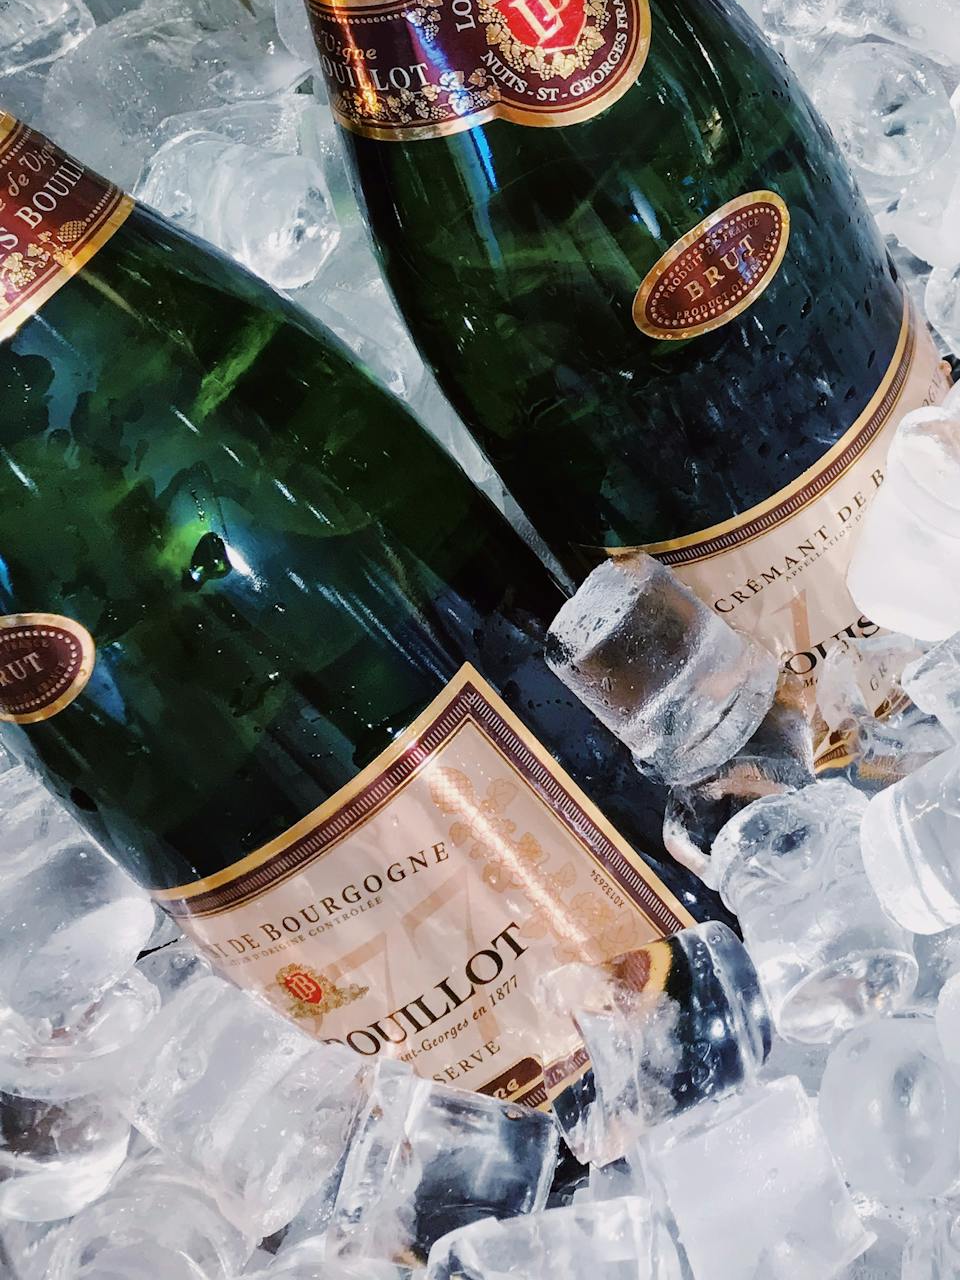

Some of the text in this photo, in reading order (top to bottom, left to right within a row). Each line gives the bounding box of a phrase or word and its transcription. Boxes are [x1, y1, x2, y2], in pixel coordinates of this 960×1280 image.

[321, 55, 431, 91] OUILLOT
[480, 50, 528, 94] NUITS
[536, 87, 559, 101] ST
[569, 31, 628, 97] GEORGES
[662, 253, 704, 299] PRODUIT
[683, 233, 756, 302] BRUT
[676, 291, 729, 319] PRODUCT
[714, 491, 867, 614] CRÉMANT DE
[786, 524, 853, 582] APPELLATION
[228, 841, 450, 954] DE BOURGOGNE
[308, 895, 384, 937] CONTRÔLÉE
[322, 922, 529, 1056] OUILLOT
[472, 1006, 488, 1022] en
[489, 975, 519, 1008] 1877
[432, 1040, 501, 1084] SERVE
